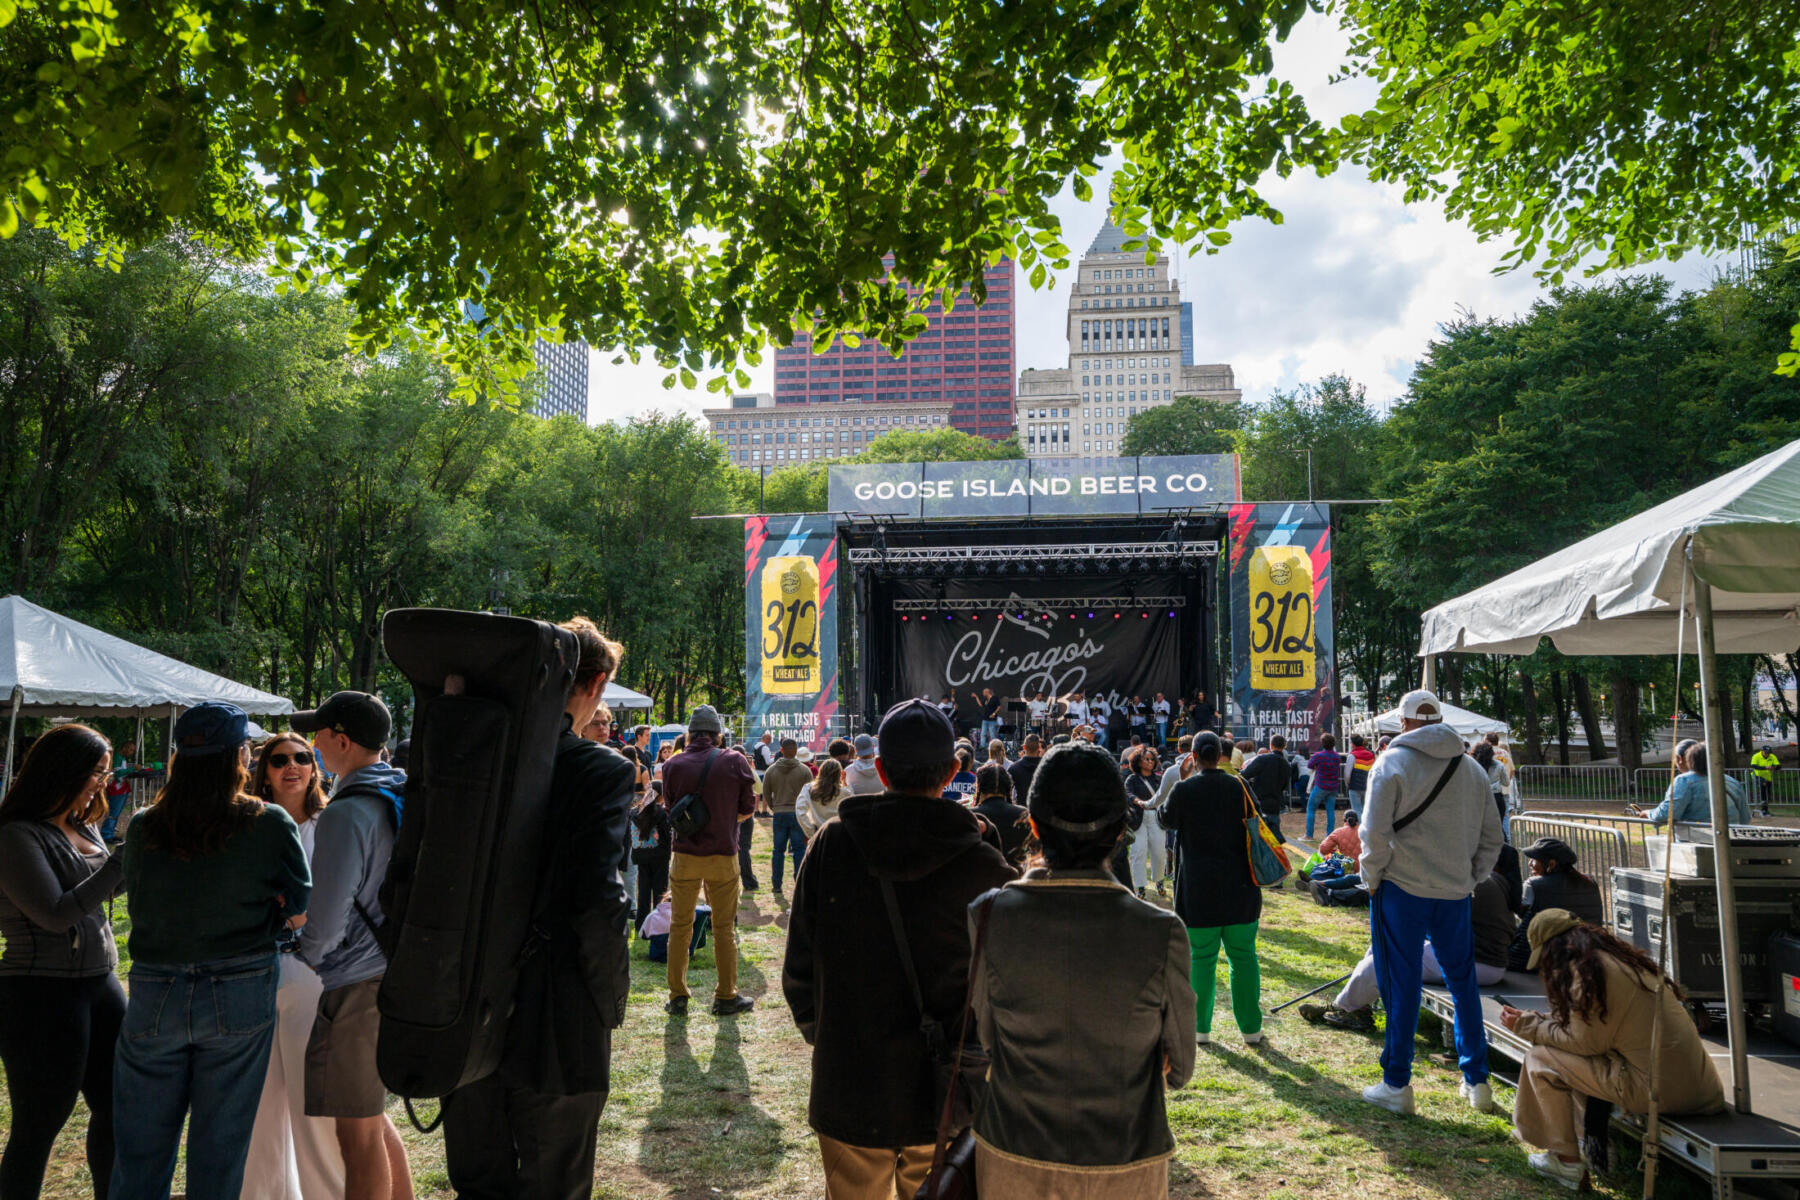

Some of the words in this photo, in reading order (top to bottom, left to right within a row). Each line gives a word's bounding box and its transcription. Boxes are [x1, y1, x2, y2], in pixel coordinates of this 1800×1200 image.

[854, 480, 954, 501] GOOSE
[963, 476, 1071, 498] ISLAND
[1080, 475, 1158, 495] BEER
[1166, 473, 1214, 493] CO.
[763, 599, 819, 660] 312
[1251, 591, 1313, 654] 312
[946, 610, 1104, 691] Chicago's
[775, 668, 795, 679] WHEAT
[797, 668, 808, 679] ALE
[1265, 663, 1287, 675] WHEAT
[1289, 663, 1301, 675] ALE
[761, 713, 767, 727] A
[769, 713, 791, 727] REAL
[793, 712, 819, 726] TASTE
[1250, 710, 1256, 724] A
[1259, 710, 1283, 724] REAL
[1286, 710, 1314, 724] TASTE
[1254, 728, 1266, 742] OF
